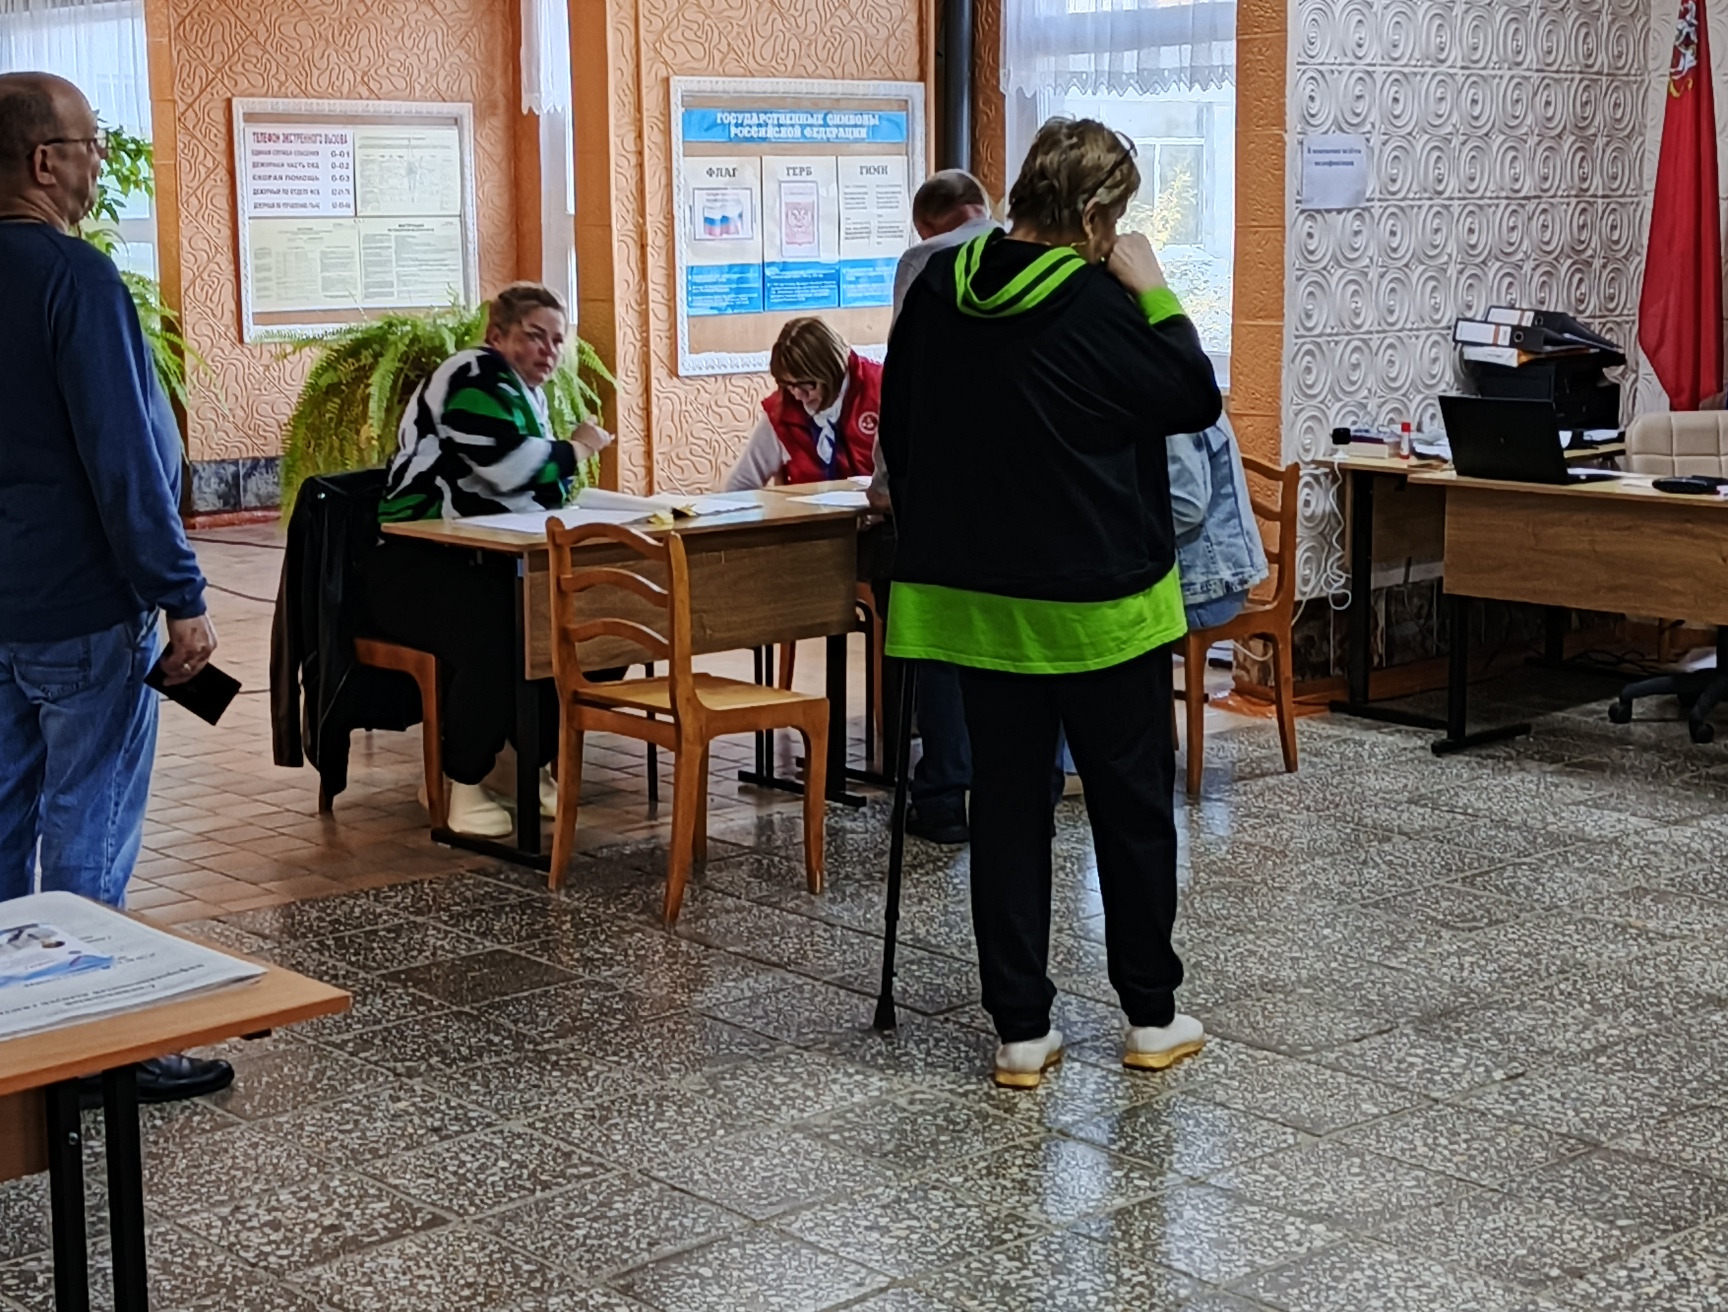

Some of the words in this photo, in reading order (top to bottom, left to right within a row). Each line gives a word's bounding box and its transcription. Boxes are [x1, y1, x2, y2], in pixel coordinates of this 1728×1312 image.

[716, 112, 824, 125] ГОСУДАРСТВЕННЫЕ
[826, 113, 879, 125] СИМВОЛЫ
[730, 125, 803, 138] РОССИЙСКОЙ
[804, 126, 868, 138] ФЕДЕРАЦИИ
[252, 132, 280, 143] ТЕЛЕФОН
[330, 150, 350, 158] 0-01
[706, 167, 739, 178] ФЛАГ
[785, 166, 813, 177] ГЕРБ
[859, 165, 888, 176] ГИМН
[252, 174, 283, 182] СКОРАЯ
[284, 174, 320, 183] ПОМОЩЬ
